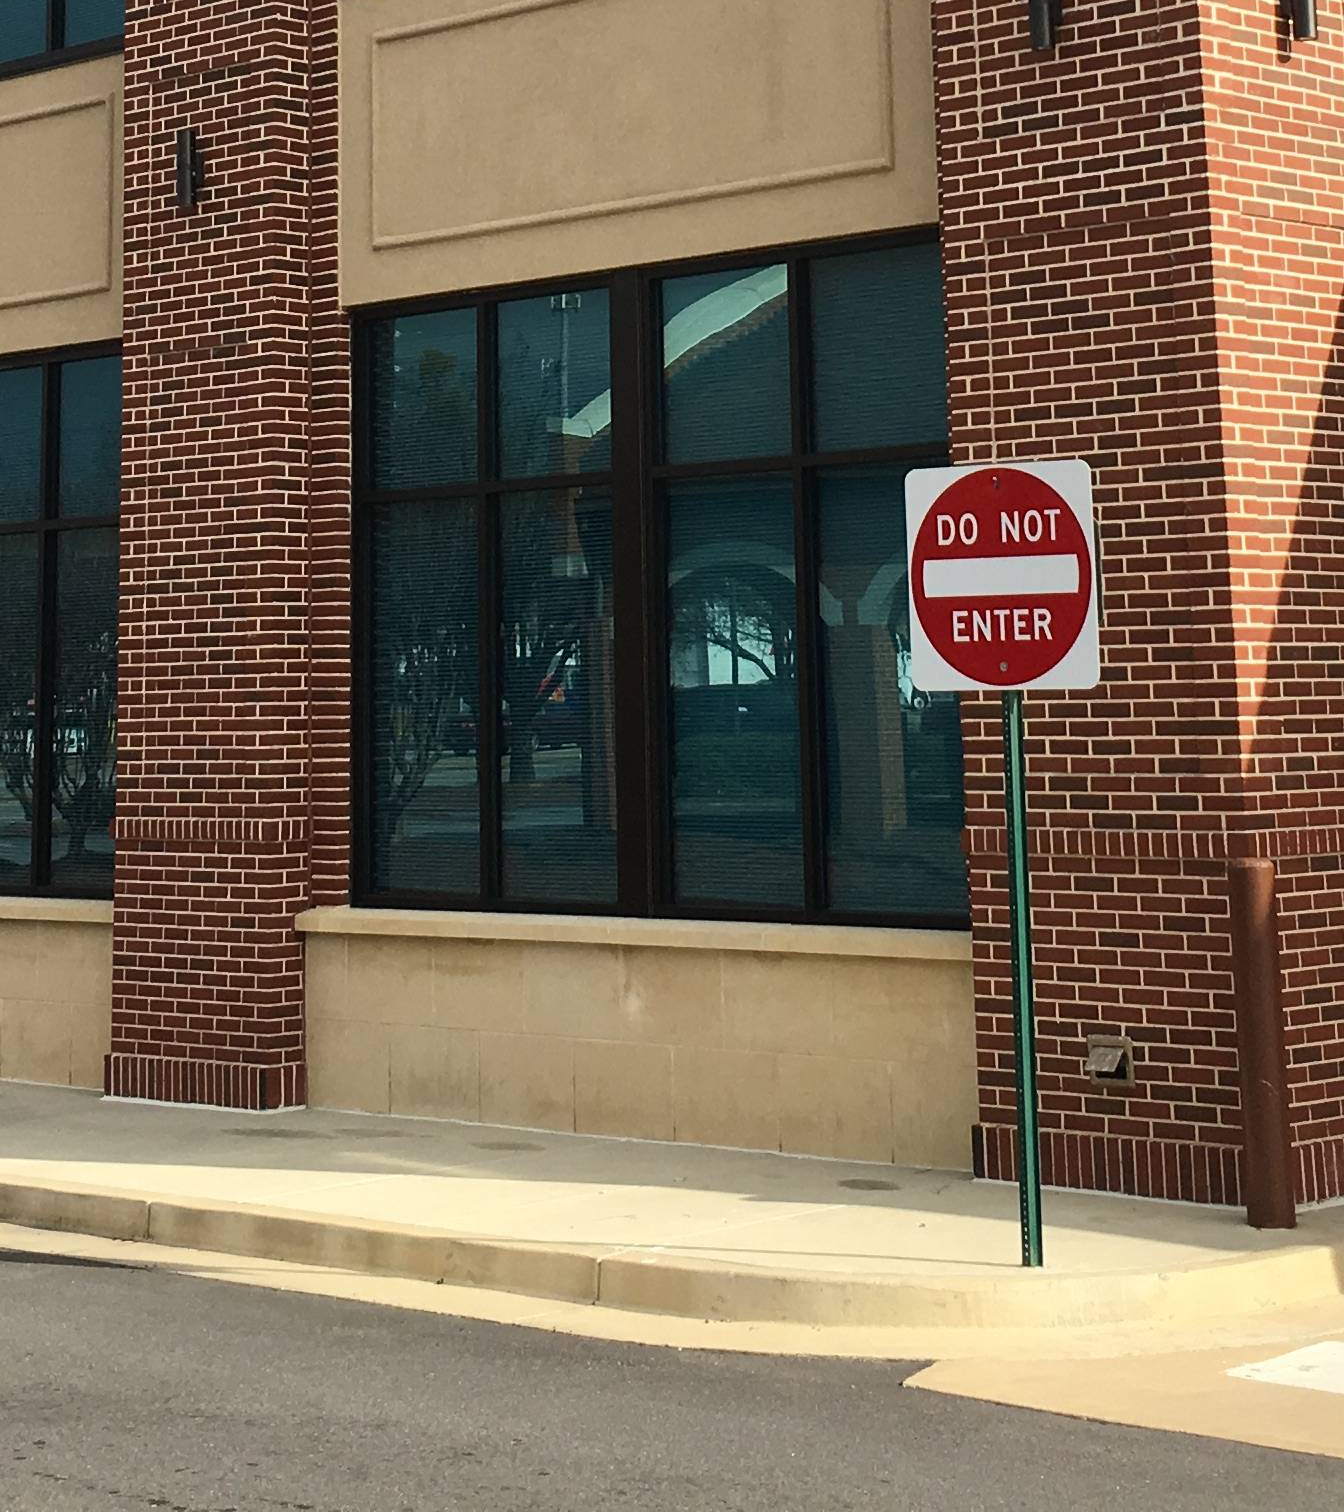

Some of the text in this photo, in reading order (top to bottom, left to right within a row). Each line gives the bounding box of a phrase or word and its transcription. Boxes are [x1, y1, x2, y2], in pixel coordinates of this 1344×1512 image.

[936, 508, 1061, 546] DO NOT
[952, 607, 1053, 643] ENTER
